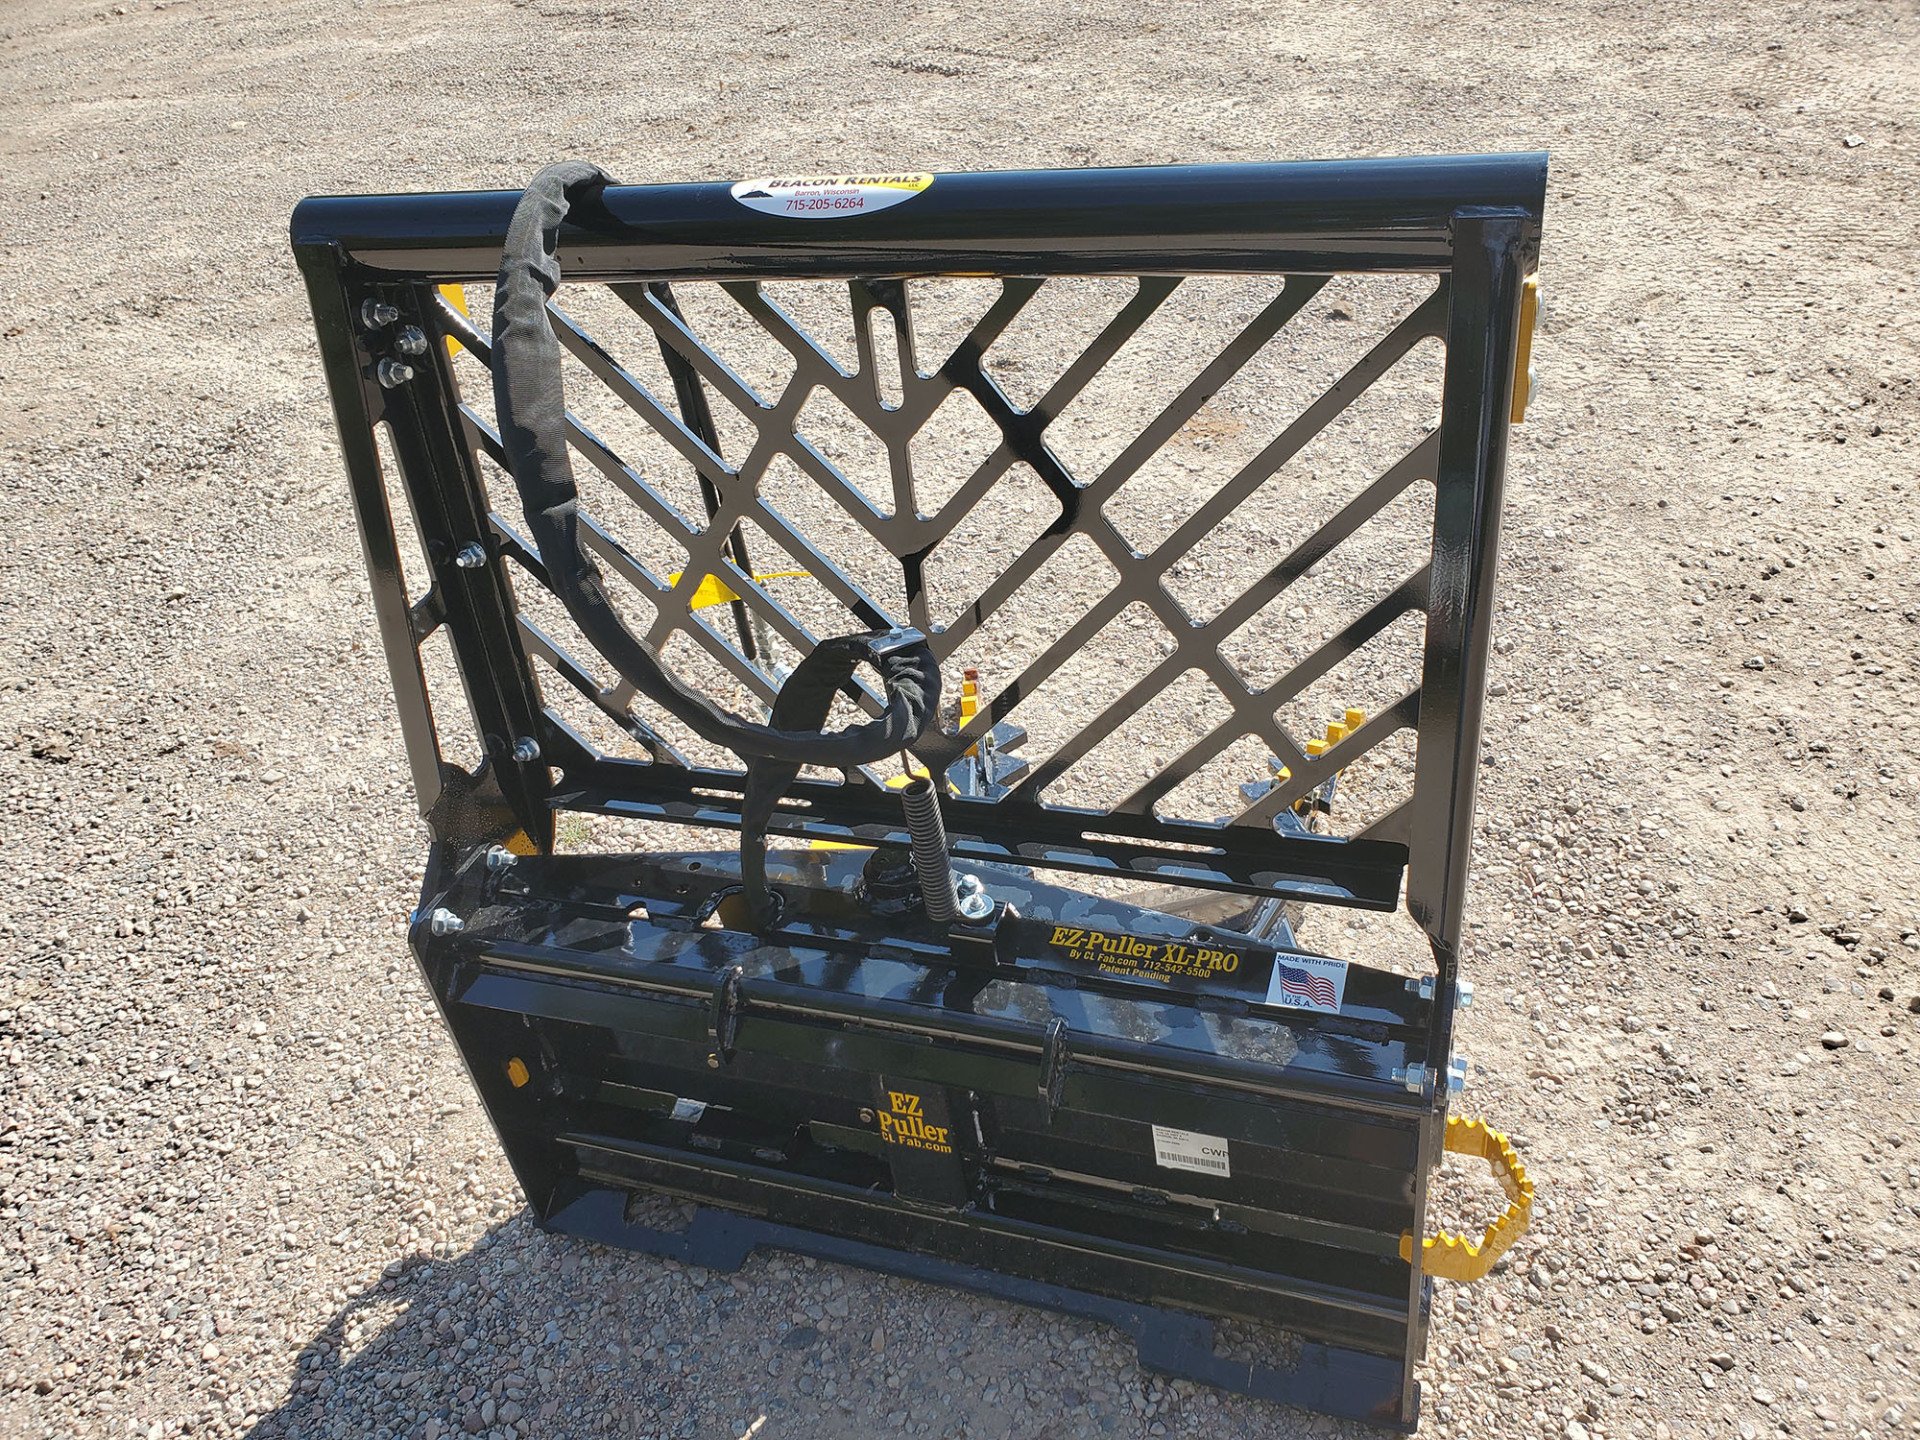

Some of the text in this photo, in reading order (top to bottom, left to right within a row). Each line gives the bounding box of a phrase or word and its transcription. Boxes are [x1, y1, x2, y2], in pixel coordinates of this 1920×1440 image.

[769, 175, 922, 188] BEACON RENTALS
[786, 197, 864, 211] 715-205-6264
[1049, 927, 1239, 972] EZ-Puller XL-PRO
[1278, 955, 1299, 963] MADE
[1302, 957, 1321, 965] WITH
[1069, 949, 1211, 978] By CL Fab.com 712-542-5500
[1098, 963, 1170, 983] Patent Pending
[1284, 998, 1313, 1008] U.S.A.
[888, 1091, 923, 1117] EZ
[876, 1109, 948, 1143] Puller
[881, 1131, 952, 1153] CL Fab.com
